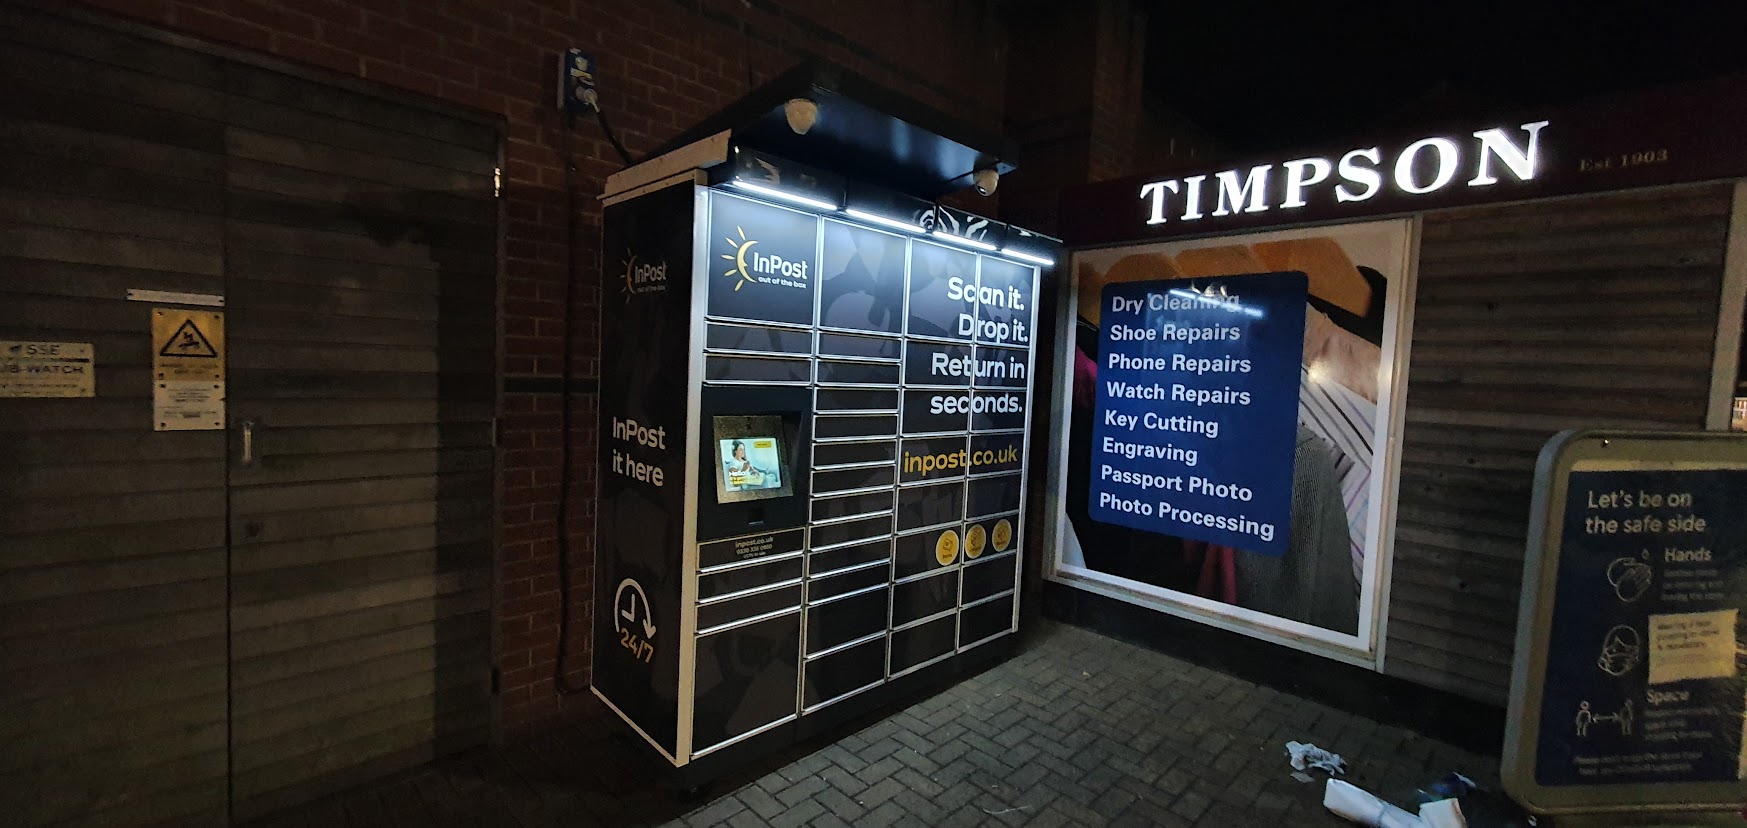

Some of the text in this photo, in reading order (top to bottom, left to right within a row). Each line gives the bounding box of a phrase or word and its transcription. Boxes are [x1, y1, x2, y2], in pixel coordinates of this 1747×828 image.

[1139, 119, 1550, 226] TIMPSON
[634, 260, 667, 284] InPost
[753, 251, 808, 280] InPost
[947, 276, 1025, 311] Scan it.
[1112, 296, 1144, 316] Dry
[958, 312, 1029, 344] Drop it.
[1110, 323, 1241, 344] Shoe Repairs
[931, 352, 1025, 379] Return in
[1108, 353, 1252, 376] Phone Repairs
[930, 392, 1023, 415] seconds.
[1106, 381, 1251, 406] Watch Repairs
[612, 416, 666, 450] InPost
[1104, 409, 1219, 439] Key Cutting
[903, 444, 1018, 477] inpost.co.uk
[1102, 436, 1198, 467] Engraving
[612, 448, 664, 487] it here
[1101, 464, 1253, 502] Passport Photo
[1587, 489, 1693, 510] Let's be on
[1099, 491, 1275, 542] Photo Processing
[1585, 513, 1707, 535] the safe side
[1664, 547, 1712, 562] Hands
[620, 627, 654, 664] 24/7
